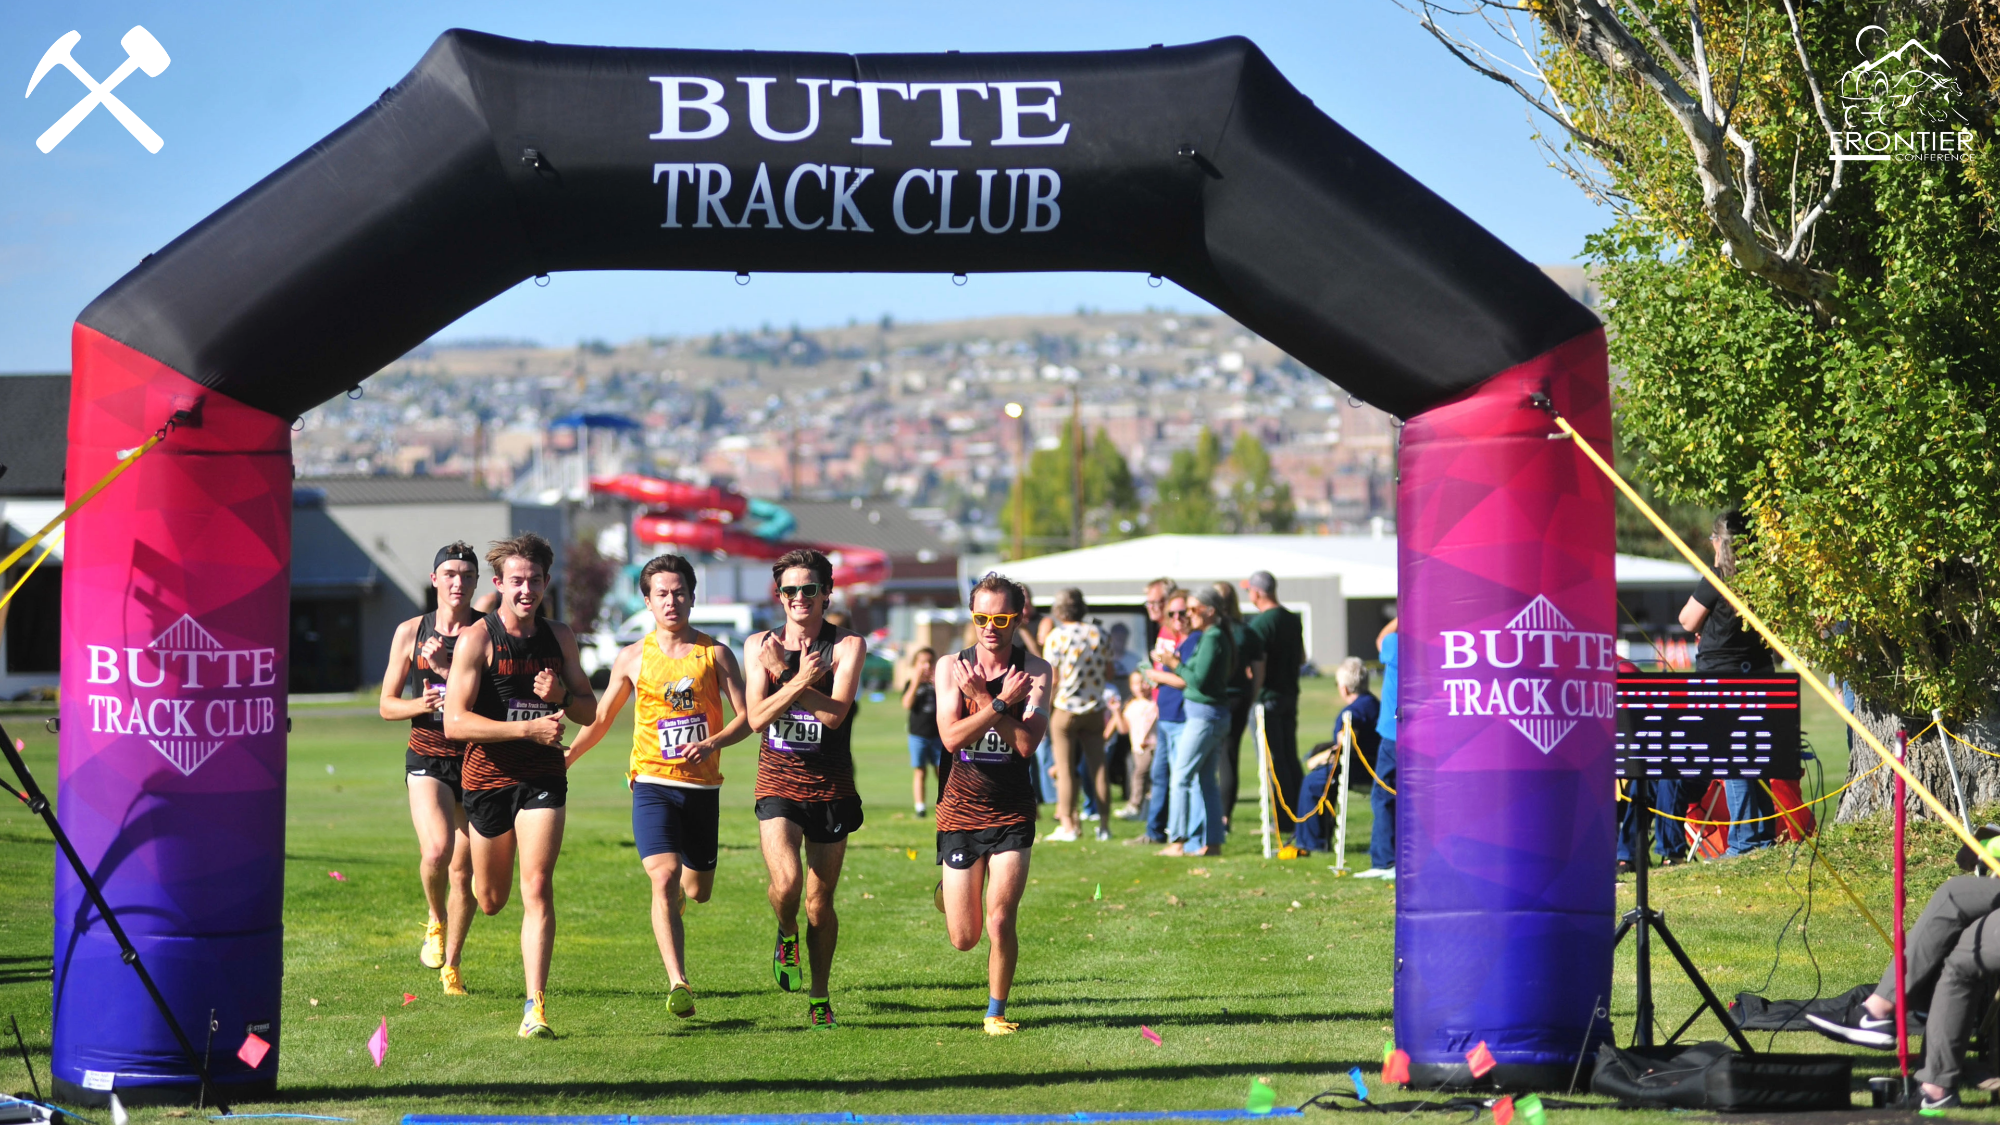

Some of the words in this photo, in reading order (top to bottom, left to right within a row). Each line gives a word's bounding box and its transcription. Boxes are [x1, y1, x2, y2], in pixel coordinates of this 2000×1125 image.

[649, 76, 1070, 147] BUTTE
[653, 162, 874, 233] TRACK
[892, 168, 1062, 235] CLUB
[86, 645, 276, 688] BUTTE
[1439, 630, 1615, 672] BUTTE
[88, 694, 197, 737] TRACK
[205, 697, 275, 737] CLUB
[1443, 678, 1554, 716] TRACK
[1561, 679, 1615, 719] CLUB
[662, 723, 707, 748] 1770
[773, 720, 819, 742] 1799
